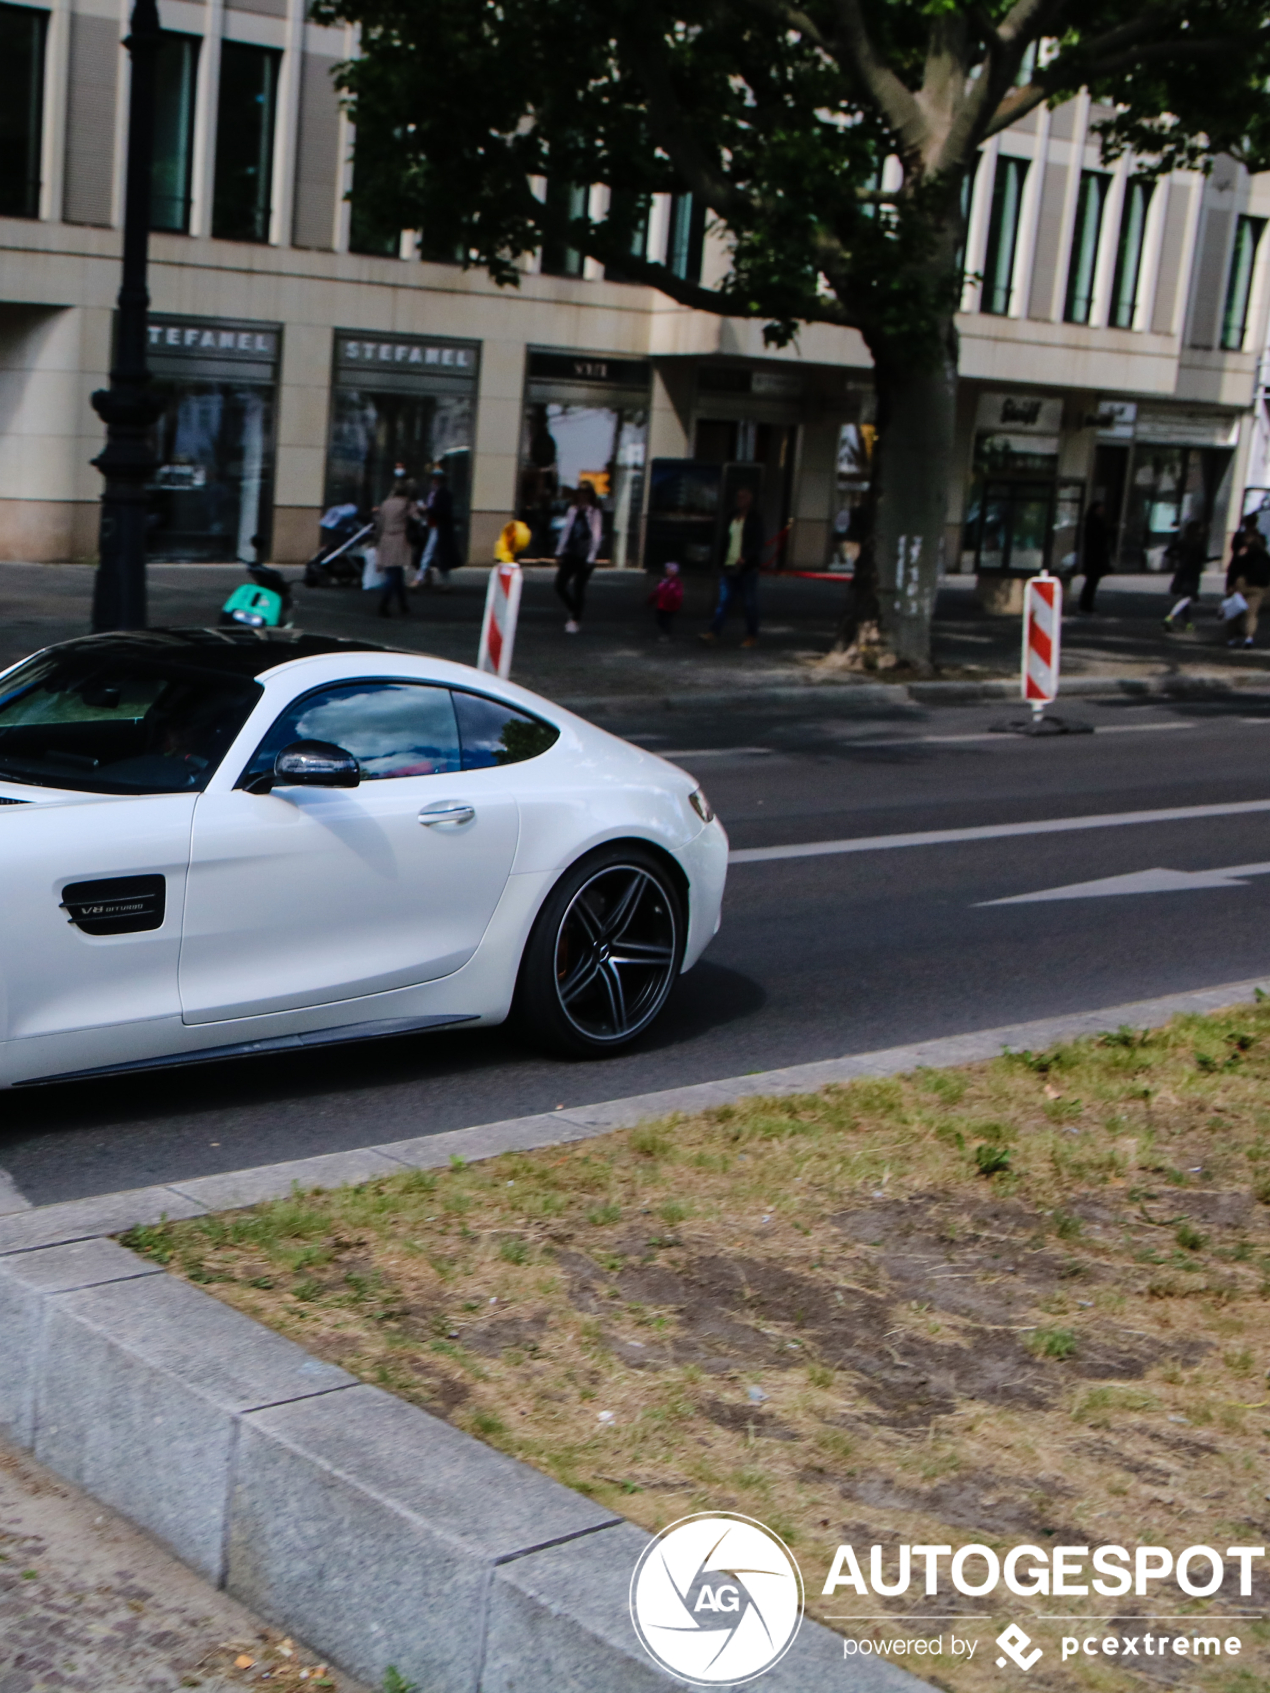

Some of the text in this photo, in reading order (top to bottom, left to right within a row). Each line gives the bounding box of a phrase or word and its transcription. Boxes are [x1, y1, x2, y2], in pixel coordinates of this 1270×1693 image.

[147, 325, 269, 351] TEFANEL
[346, 341, 468, 367] STEFANEL
[81, 905, 104, 915] V8
